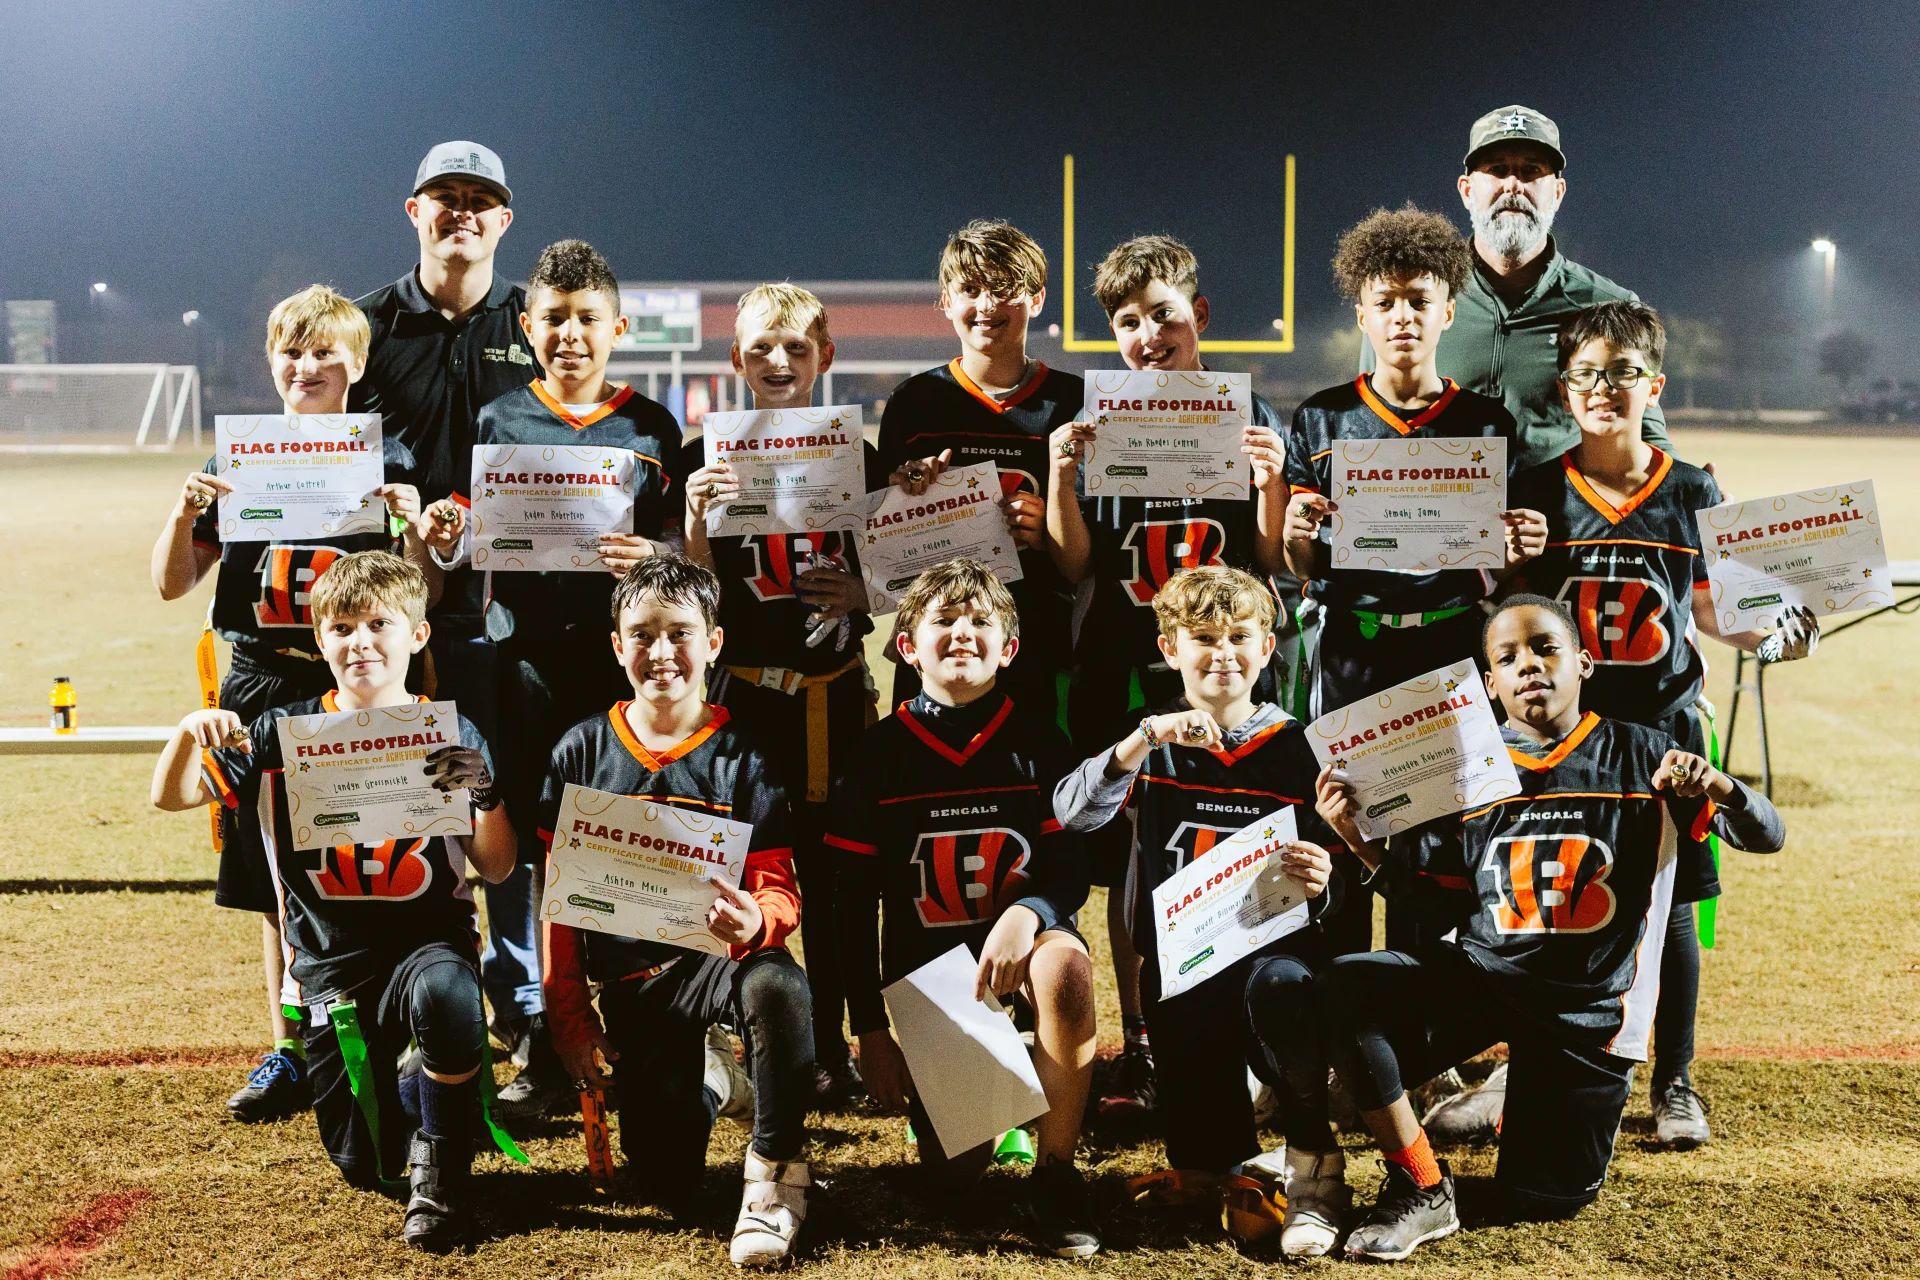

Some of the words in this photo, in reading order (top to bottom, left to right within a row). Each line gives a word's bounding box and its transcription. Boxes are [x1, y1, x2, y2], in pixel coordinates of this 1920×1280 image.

[1099, 400, 1142, 410] FLAG
[1148, 400, 1236, 411] FOOTBALL
[1178, 415, 1220, 424] ACHIEVEMENT
[231, 443, 275, 454] FLAG
[281, 441, 368, 453] FOOTBALL
[717, 439, 758, 451] FLAG
[764, 434, 849, 449] FOOTBALL
[1128, 438, 1142, 447] John
[1146, 438, 1169, 447] Rhodes
[312, 456, 352, 464] ACHIEVEMENT
[795, 449, 834, 460] ACHIEVEMENT
[486, 473, 528, 484] FLAG
[534, 473, 620, 485] FOOTBALL
[1347, 470, 1393, 480] FLAG
[1399, 468, 1490, 480] FOOTBALL
[266, 482, 291, 491] Arthur
[1431, 483, 1474, 492] ACHIEVEMENT
[1145, 498, 1203, 508] BENGALS
[551, 511, 584, 520] Robertson
[866, 512, 903, 530] FLAG
[906, 491, 989, 519] FOOTBALL
[880, 523, 924, 538] CERTIFICATE
[938, 507, 976, 524] ACHIEVEMENT
[1716, 527, 1764, 546] FLAG
[1769, 509, 1863, 536] FOOTBALL
[1735, 540, 1787, 554] CERTIFICATE
[1804, 526, 1848, 541] ACHIEVEMENT
[1328, 729, 1377, 756] FLAG
[1379, 694, 1472, 735] FOOTBALL
[1351, 738, 1403, 760] CERTIFICATE
[1418, 714, 1460, 736] ACHIEVEMENT
[297, 742, 344, 757] FLAG
[350, 732, 446, 753] FOOTBALL
[1421, 746, 1456, 763] Robinson
[315, 758, 369, 767] CERTIFICATE
[930, 806, 998, 817] BENGALS
[1197, 803, 1260, 814] BENGALS
[1510, 811, 1582, 822] BENGALS
[573, 820, 623, 842] FLAG
[628, 833, 727, 865] FOOTBALL
[586, 842, 643, 861] CERTIFICATE
[660, 856, 706, 876] ACHIEVEMENT
[604, 874, 634, 888] Ashton
[1167, 886, 1202, 919] FLAG
[1206, 840, 1283, 890] FOOTBALL
[1180, 892, 1221, 921] CERTIFICATE
